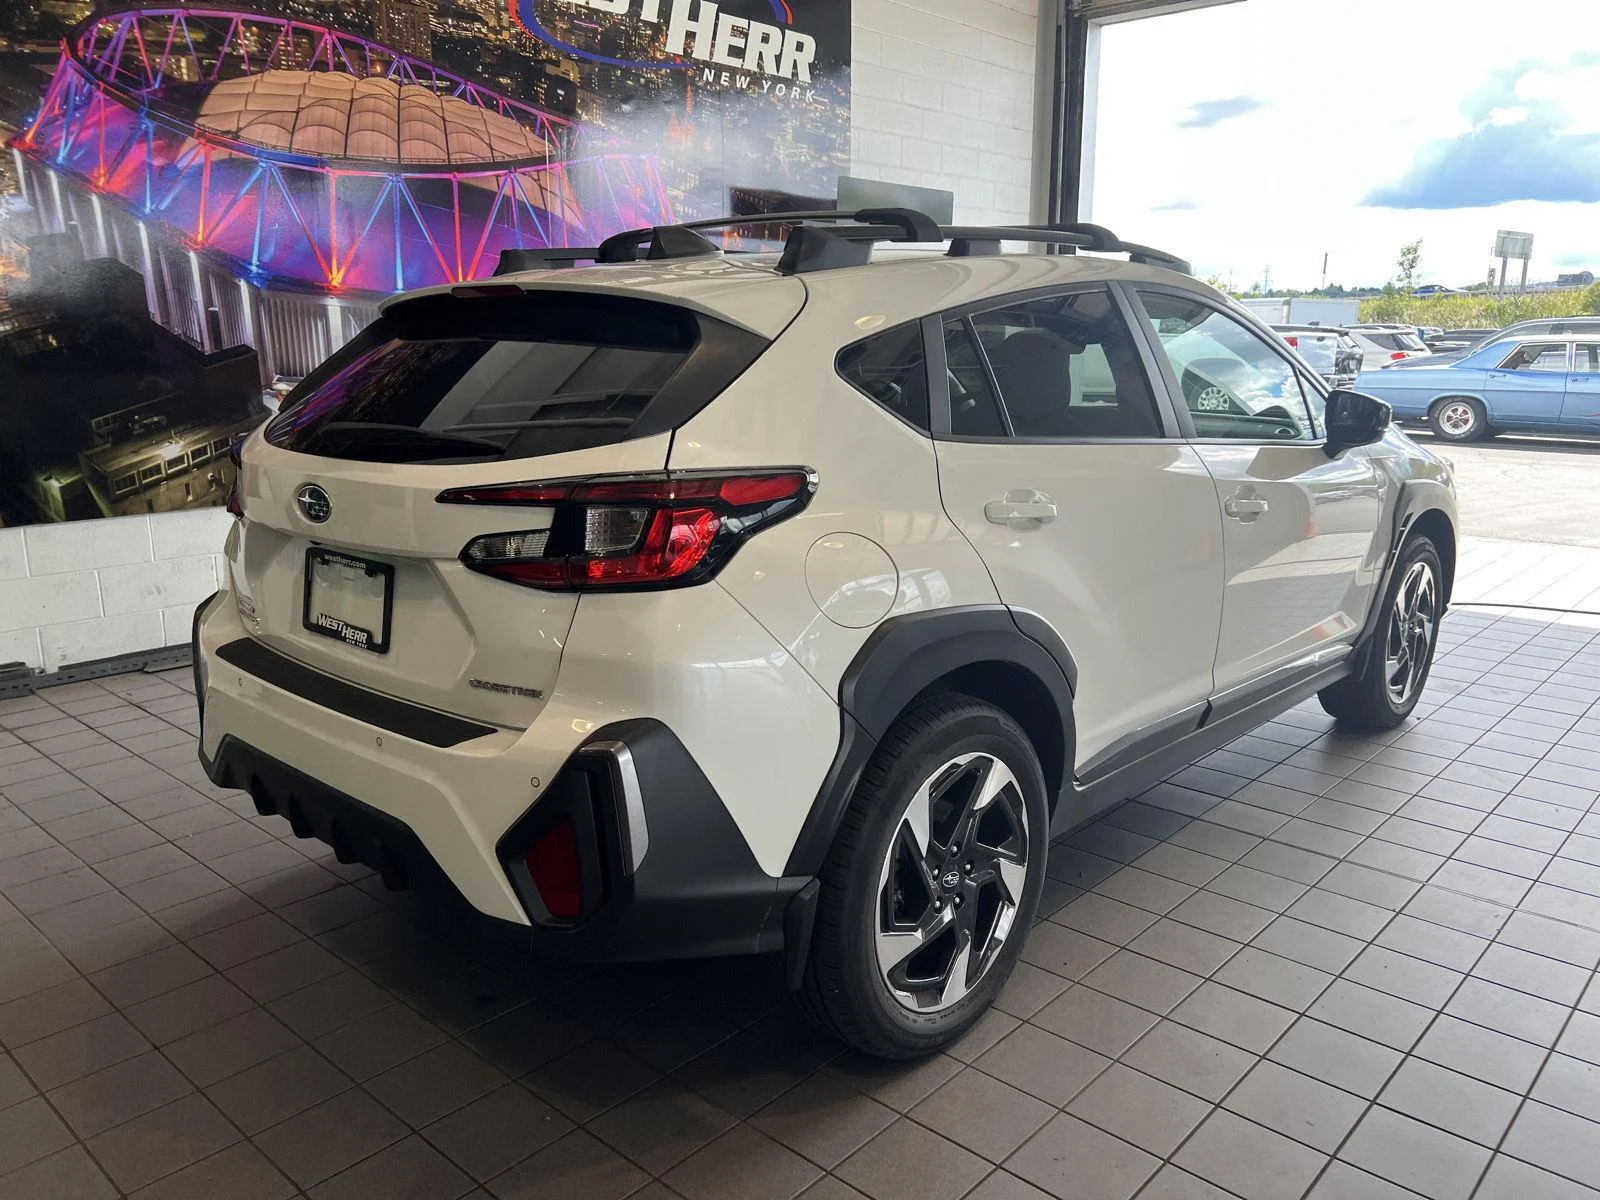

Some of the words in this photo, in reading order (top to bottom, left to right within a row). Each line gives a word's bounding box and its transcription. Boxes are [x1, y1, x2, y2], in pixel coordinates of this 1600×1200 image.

[664, 0, 817, 83] HERR
[703, 68, 750, 89] NEW
[762, 80, 815, 103] YORK
[324, 554, 366, 569] westherr.com
[318, 614, 344, 631] WEST
[341, 625, 368, 643] HERR
